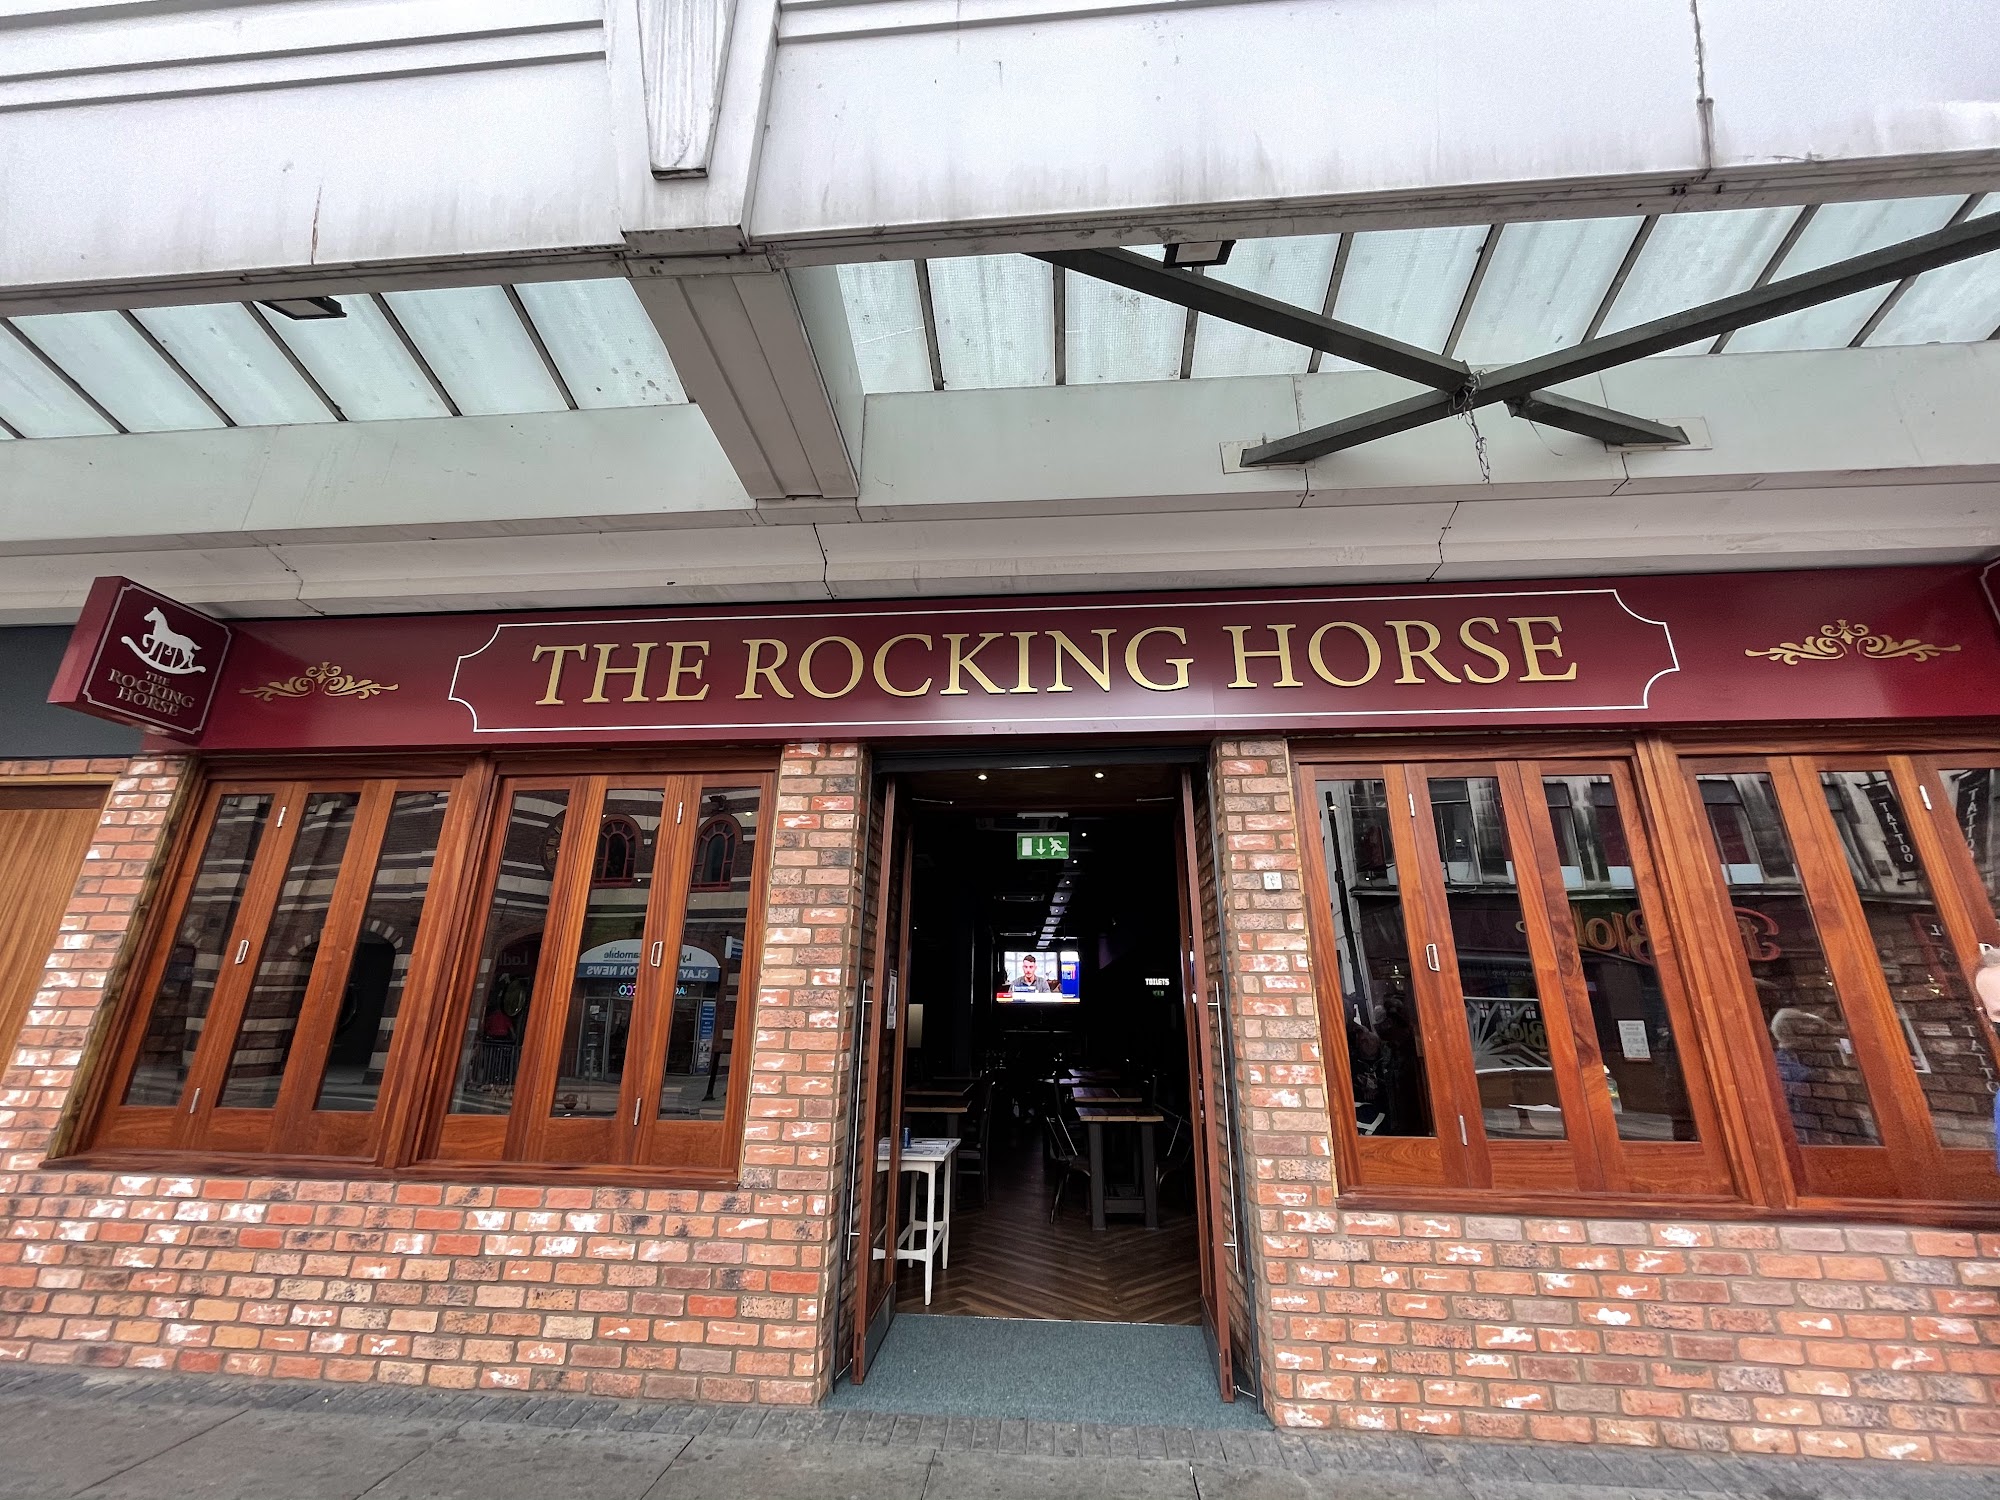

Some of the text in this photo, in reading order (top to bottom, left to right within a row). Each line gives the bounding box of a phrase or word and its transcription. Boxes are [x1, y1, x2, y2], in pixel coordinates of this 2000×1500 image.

[531, 615, 1578, 706] THE ROCKING HORSE
[109, 669, 195, 708] ROCKING
[146, 671, 171, 686] THE
[116, 686, 179, 717] HORSE
[1144, 977, 1170, 986] TOILETS
